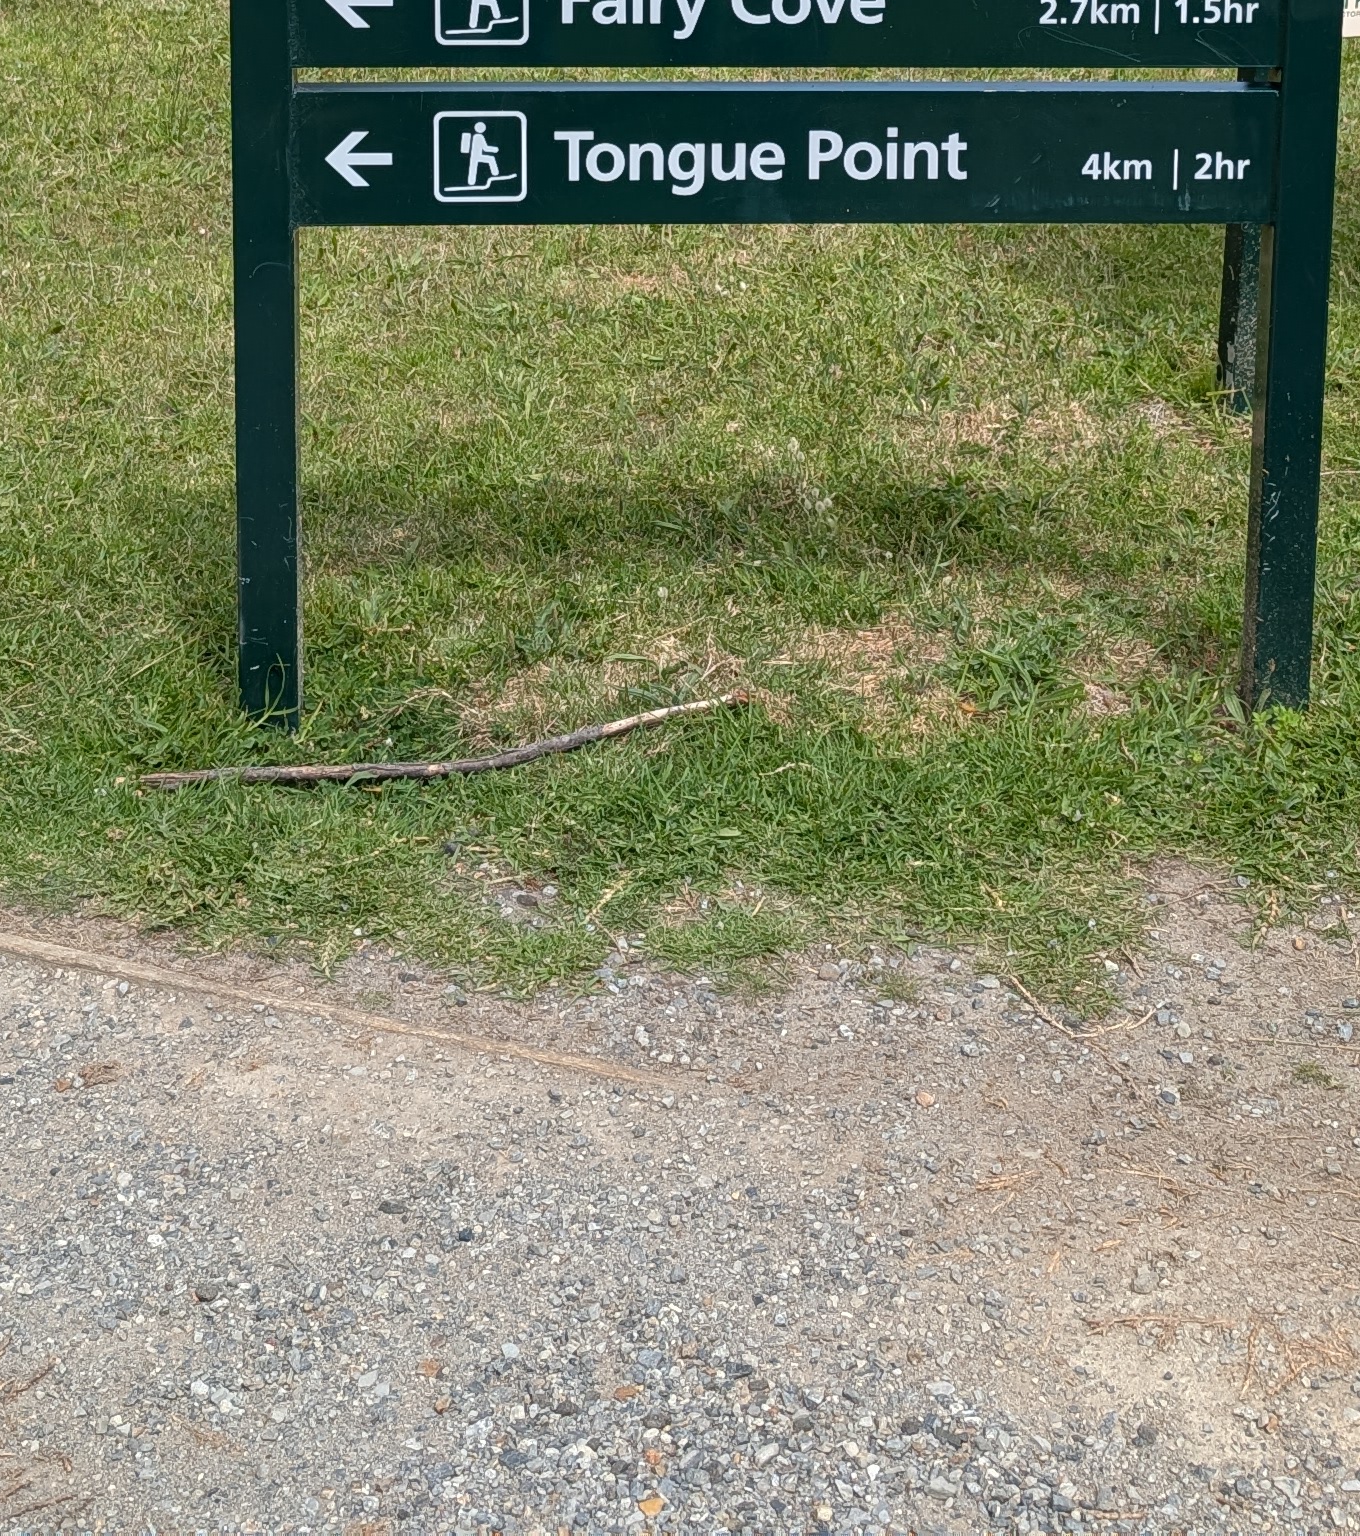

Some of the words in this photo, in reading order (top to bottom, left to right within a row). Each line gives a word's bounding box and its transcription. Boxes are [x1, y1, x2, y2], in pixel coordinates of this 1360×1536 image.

[553, 130, 786, 196] Tongue
[808, 126, 968, 181] Point
[1081, 151, 1153, 181] 4km
[1194, 151, 1251, 180] 2hr
